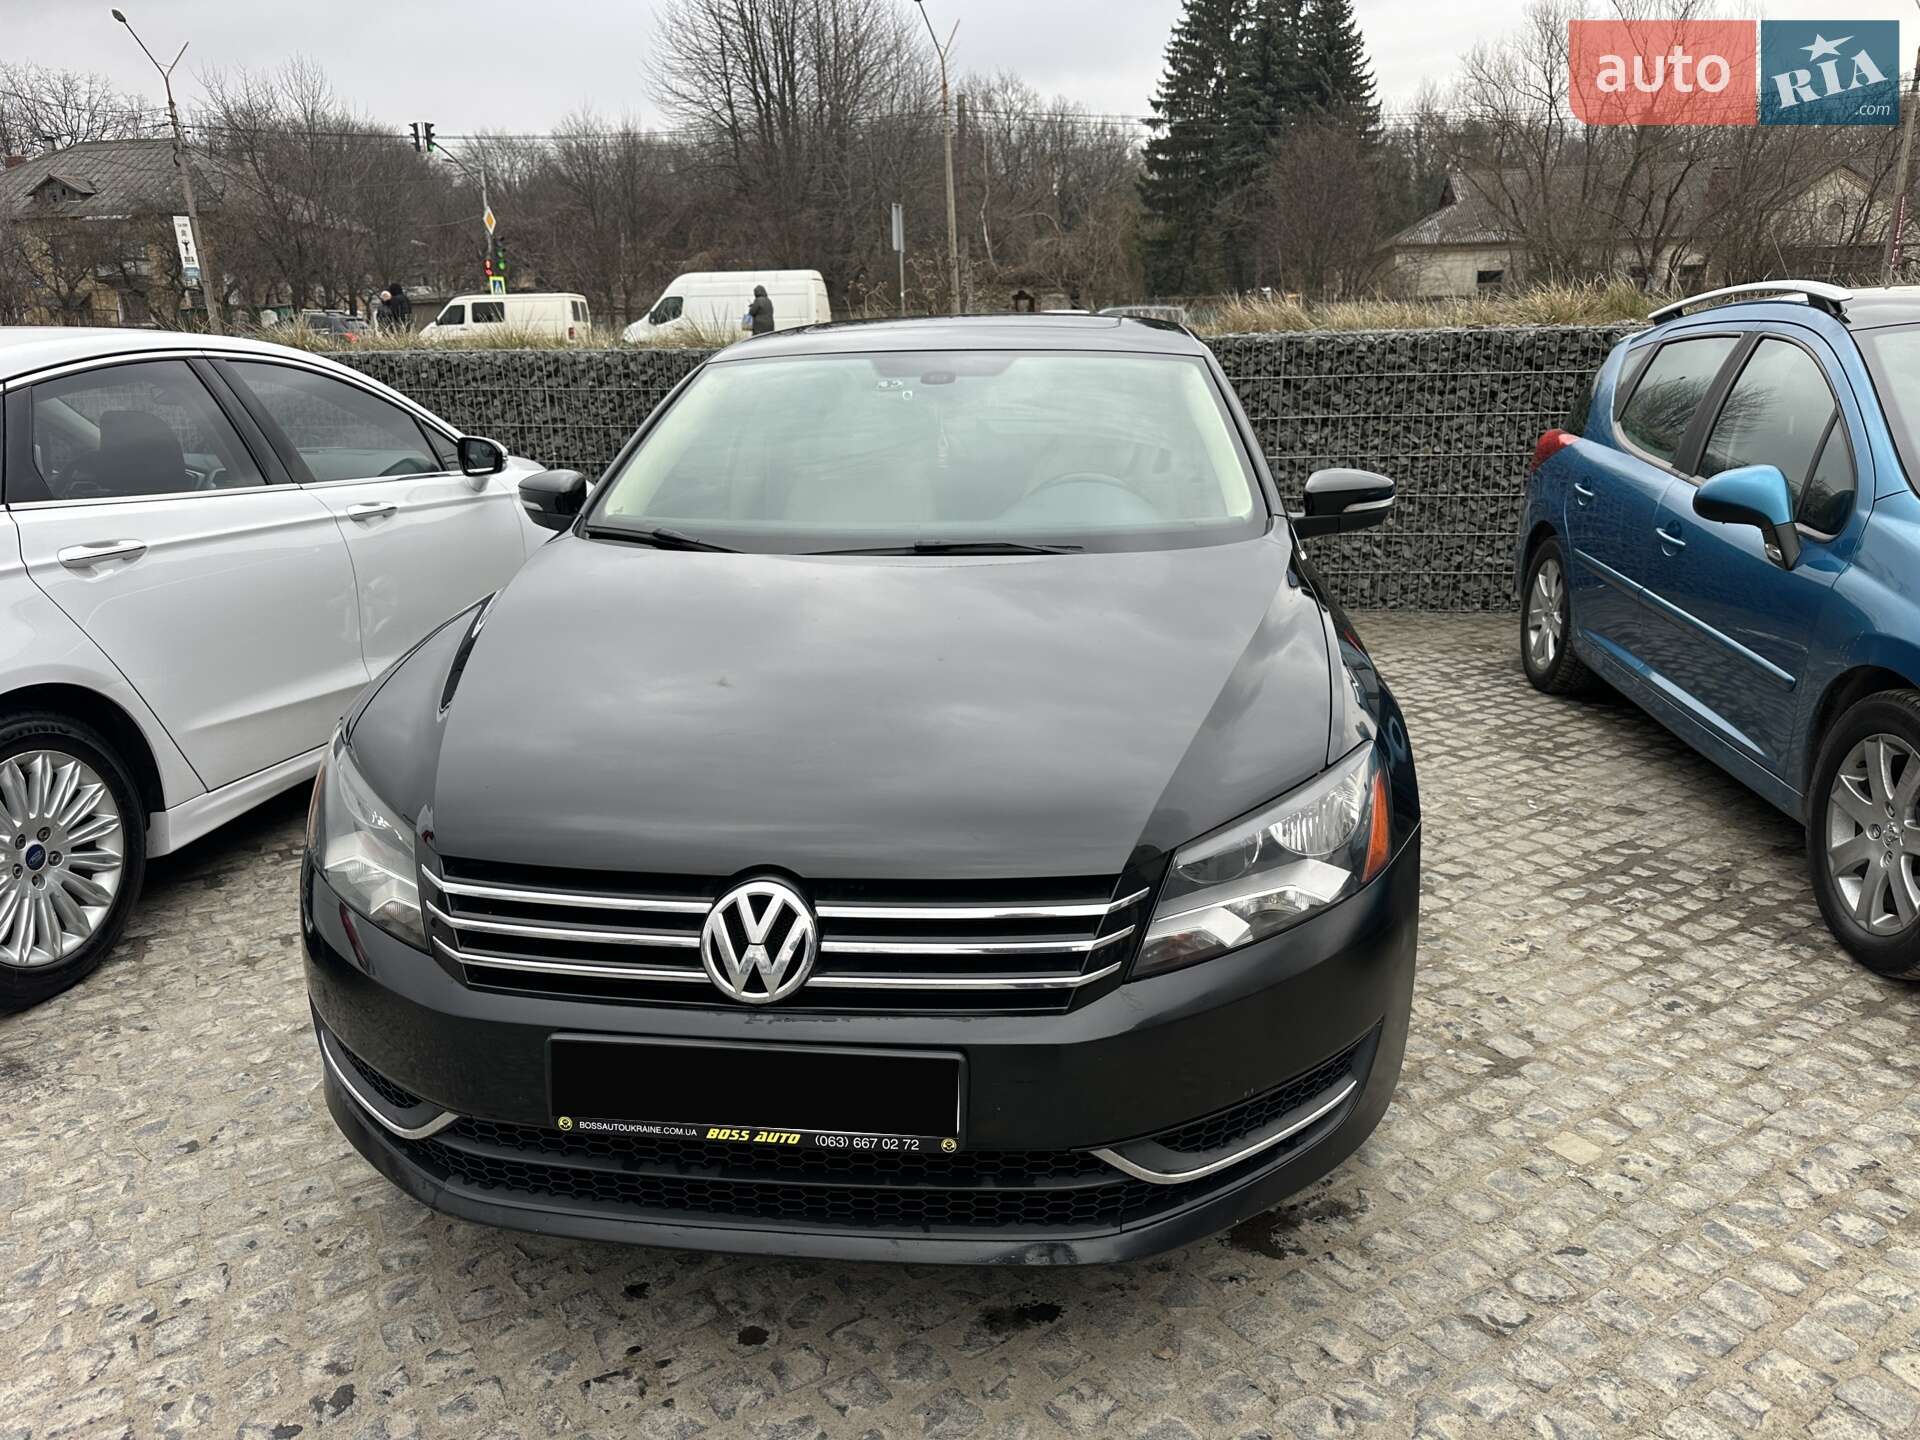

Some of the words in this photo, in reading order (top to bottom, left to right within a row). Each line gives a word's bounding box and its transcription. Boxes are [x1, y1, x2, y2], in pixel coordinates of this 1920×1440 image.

[578, 1121, 698, 1137] BOSSAUTOUKRAINE.COM.UA
[706, 1128, 750, 1141] BOSS
[753, 1131, 801, 1145] AUTO
[814, 1135, 849, 1148] (063)
[853, 1137, 878, 1149] 667
[882, 1138, 899, 1150] 02
[903, 1139, 920, 1151] 72
